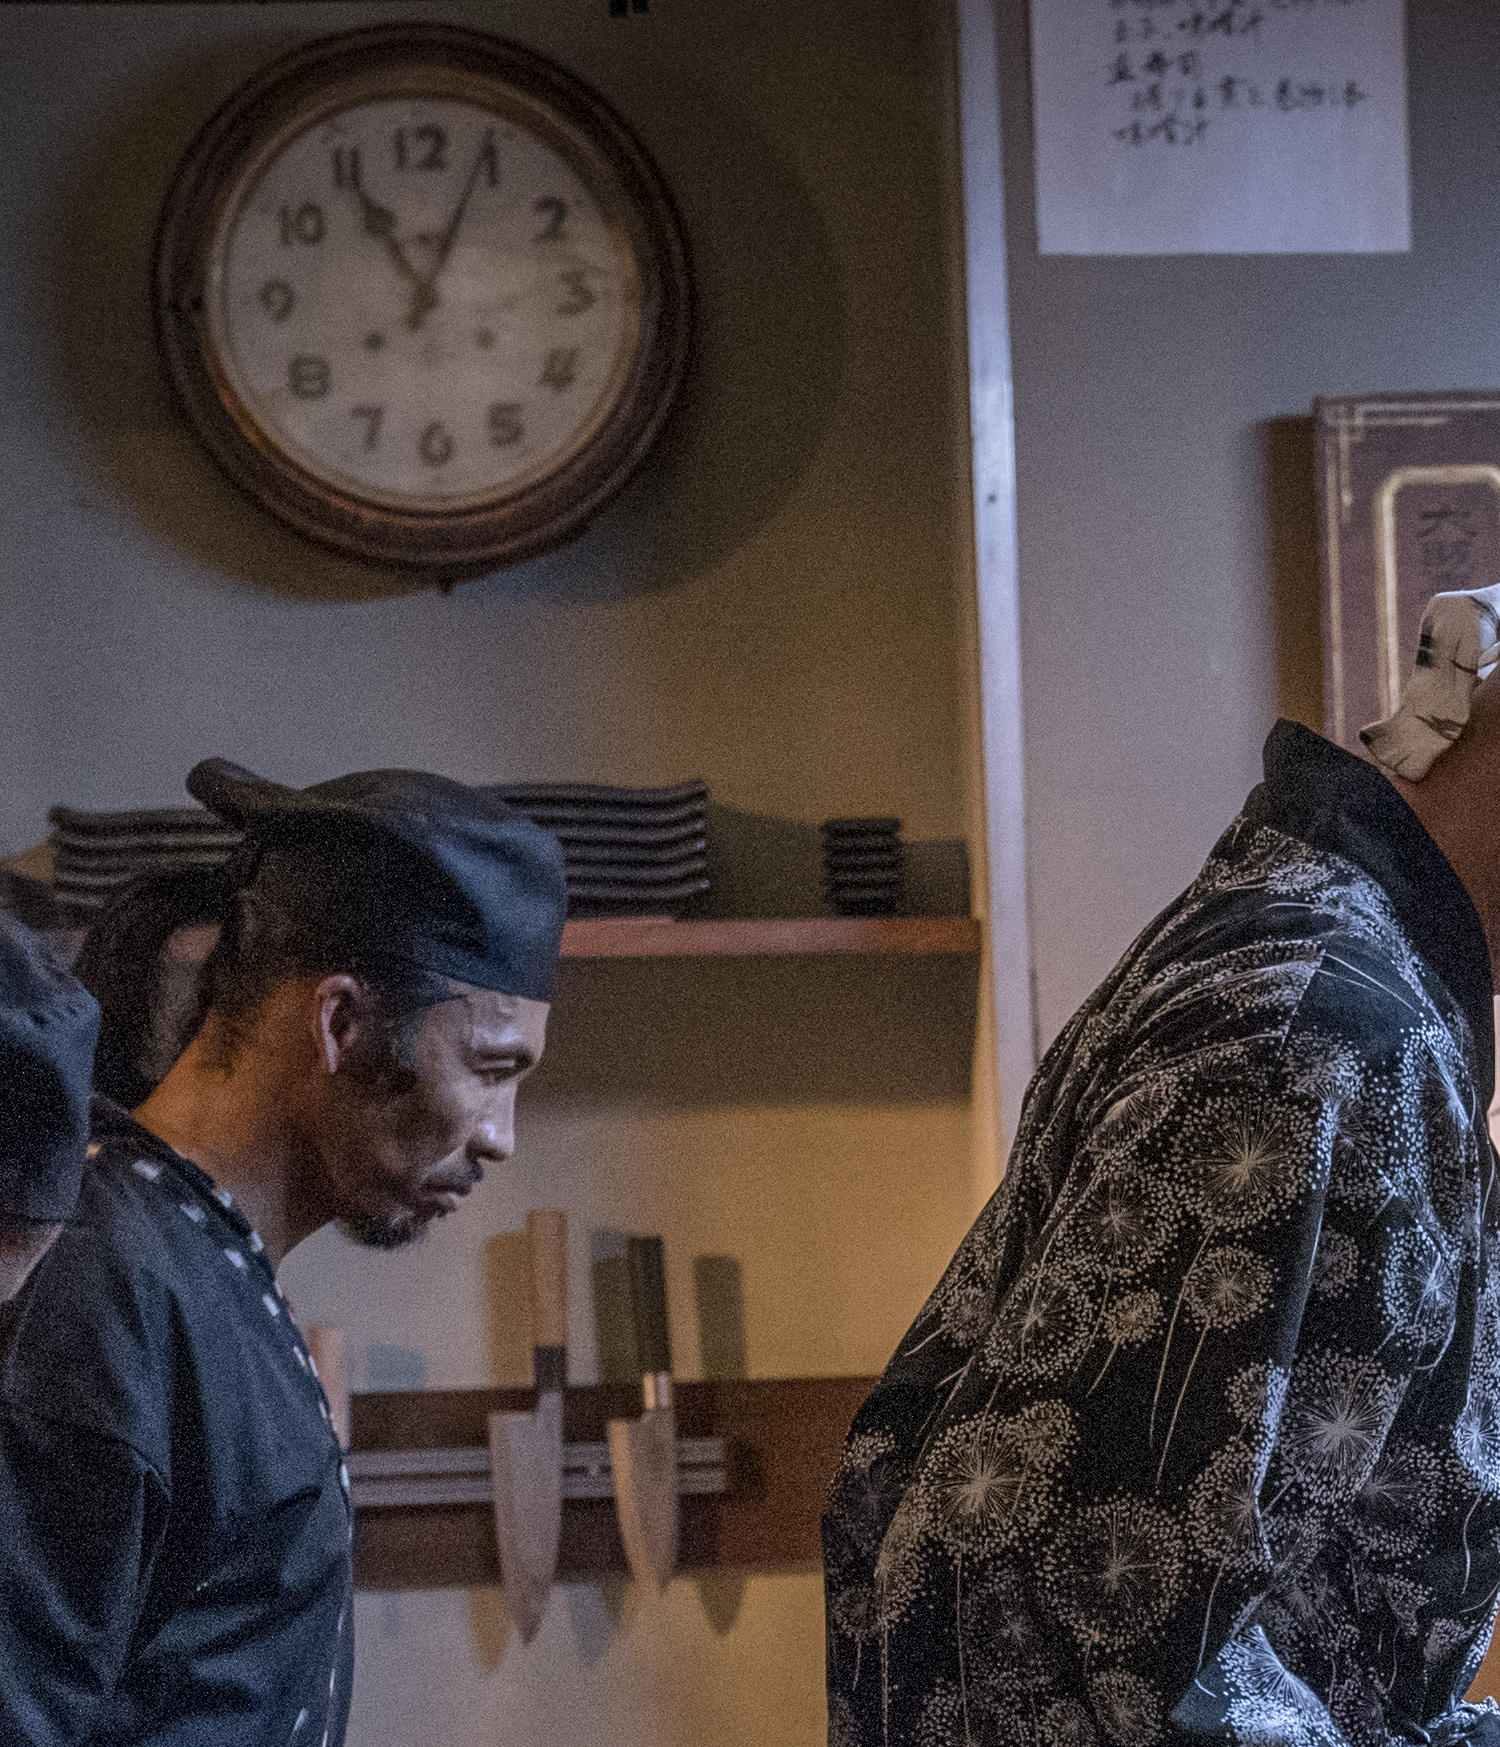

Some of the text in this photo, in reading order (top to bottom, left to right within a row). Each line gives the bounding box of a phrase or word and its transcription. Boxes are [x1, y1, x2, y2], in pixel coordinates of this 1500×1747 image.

[395, 124, 447, 171] 12
[279, 203, 326, 246] 10
[534, 198, 569, 242] 2
[260, 279, 295, 322] 9
[556, 270, 595, 316] 3
[289, 355, 331, 400] 8
[351, 405, 385, 451] 7
[418, 421, 454, 468] 6
[487, 403, 524, 448] 5
